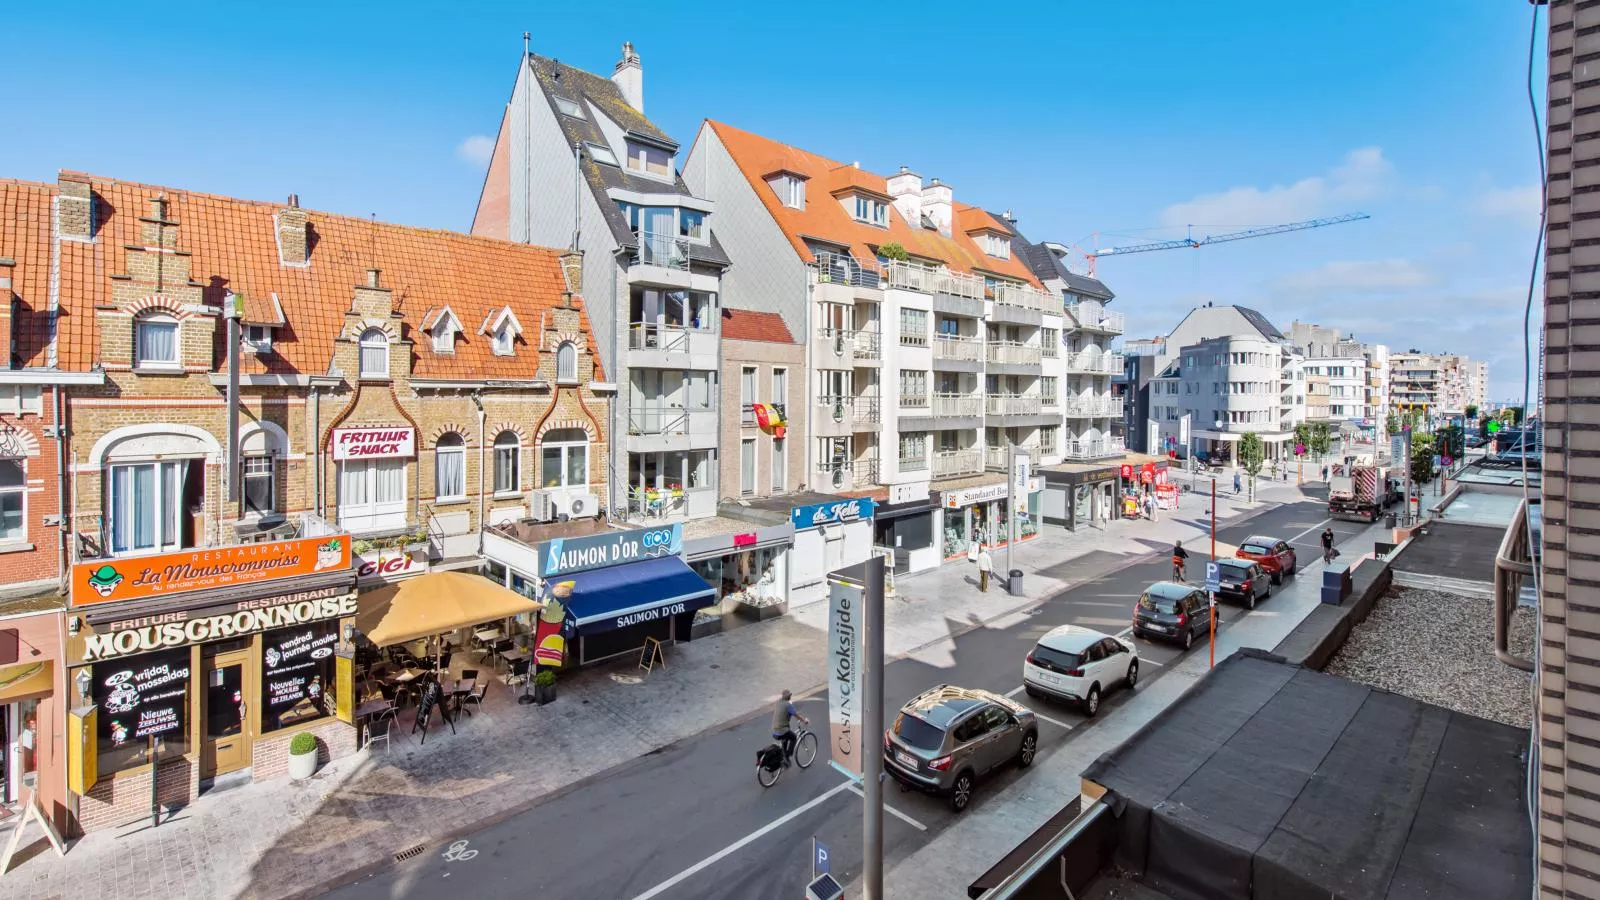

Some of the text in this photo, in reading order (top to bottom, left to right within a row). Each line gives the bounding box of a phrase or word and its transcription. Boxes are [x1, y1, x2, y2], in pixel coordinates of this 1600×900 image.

[339, 430, 410, 444] FRITUUR
[348, 443, 401, 456] SNACK
[963, 488, 996, 501] Standaard
[192, 542, 301, 562] RESTAURANT
[550, 535, 638, 571] SAUMON D'OR
[132, 552, 300, 587] La Mouscronnoise
[1206, 563, 1218, 578] P
[110, 587, 338, 631] FRITURE RESTAURANT
[617, 603, 686, 628] SAUMON D'OR
[82, 588, 358, 660] MOUSCRONNOISE
[280, 631, 313, 650] vendredi
[282, 633, 337, 661] journée moules
[835, 598, 855, 683] Koksijde
[134, 664, 169, 682] vrijdag
[137, 668, 190, 692] mosseldag
[270, 677, 305, 692] Nouvelles
[275, 685, 300, 696] MOULES
[138, 713, 177, 728] ZEEUWSE
[141, 708, 174, 721] Nieuwe
[136, 721, 179, 737] MOSSELEN
[818, 848, 828, 864] P
